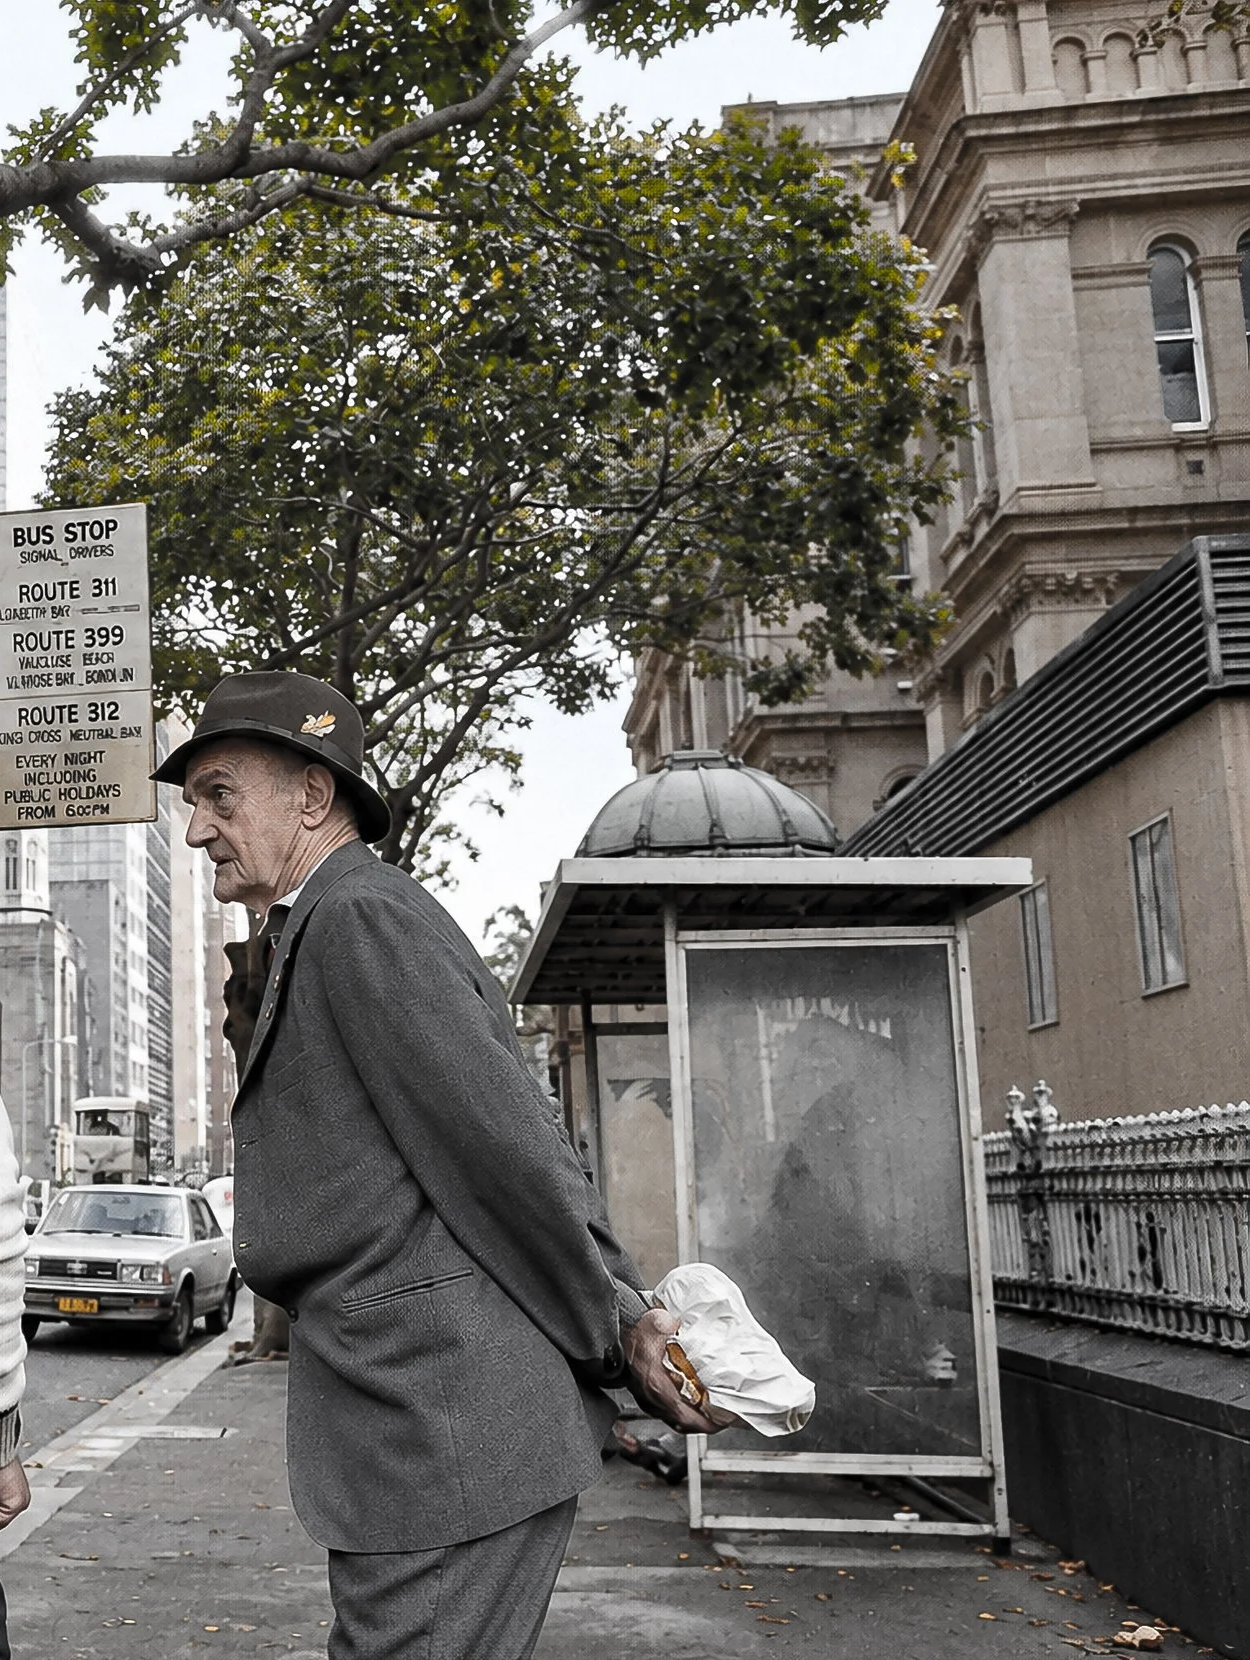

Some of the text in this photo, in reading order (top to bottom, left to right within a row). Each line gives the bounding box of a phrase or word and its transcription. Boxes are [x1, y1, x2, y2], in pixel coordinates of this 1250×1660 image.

[13, 519, 118, 547] BUS STOP
[19, 577, 117, 603] ROUTE 311
[13, 625, 124, 652] ROUTE 399
[18, 701, 119, 727] ROUTE 312
[16, 750, 105, 768] EVERY NIGHT
[24, 769, 96, 786] INCLUDING
[17, 806, 55, 819] FROM
